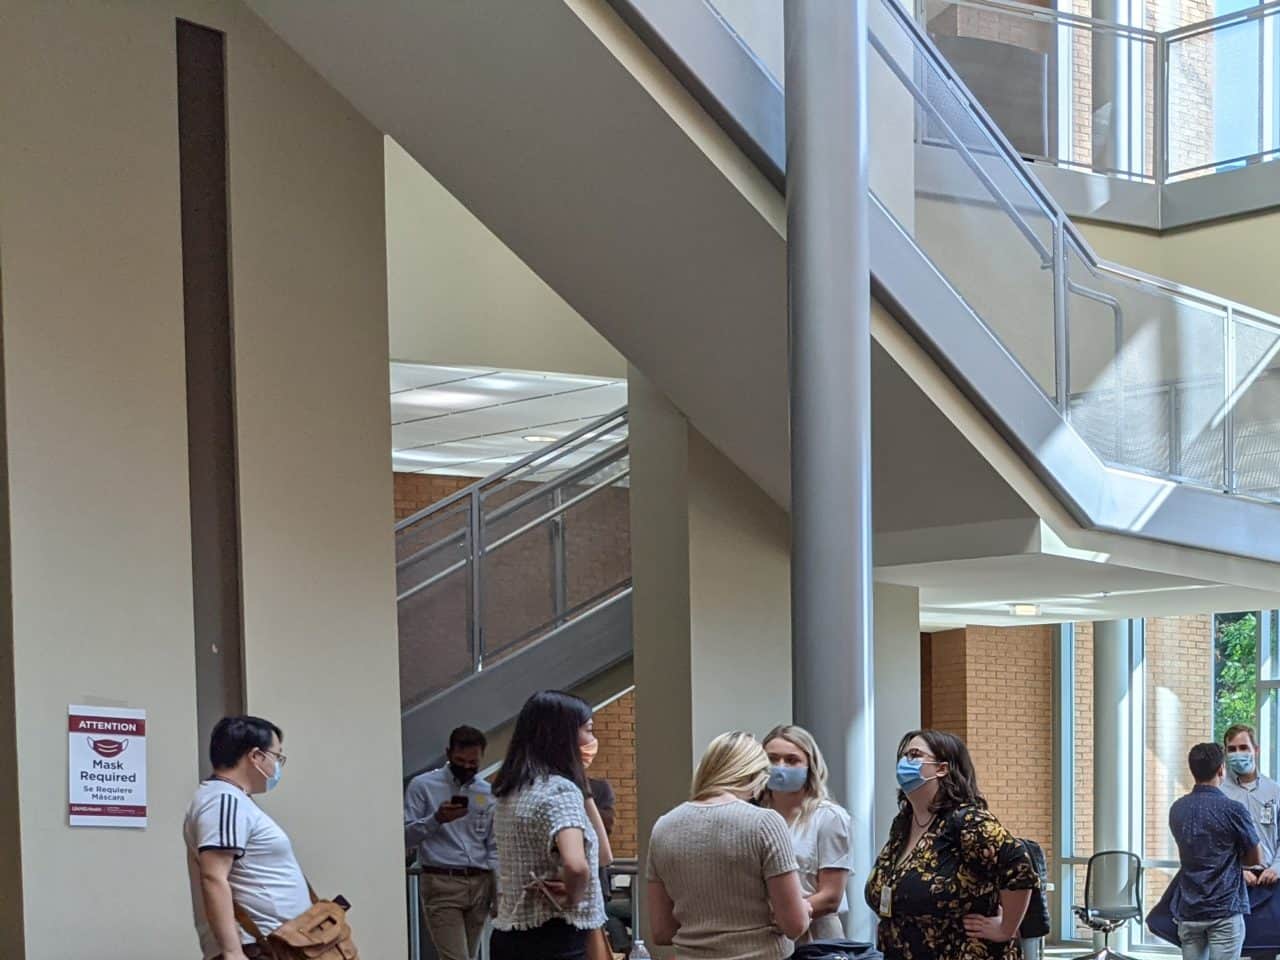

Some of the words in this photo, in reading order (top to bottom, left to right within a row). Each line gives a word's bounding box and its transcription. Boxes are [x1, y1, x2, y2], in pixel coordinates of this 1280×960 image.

[78, 720, 137, 732] ATTENTION
[92, 759, 124, 770] Mask
[80, 771, 136, 783] Required
[95, 785, 133, 794] Requiere
